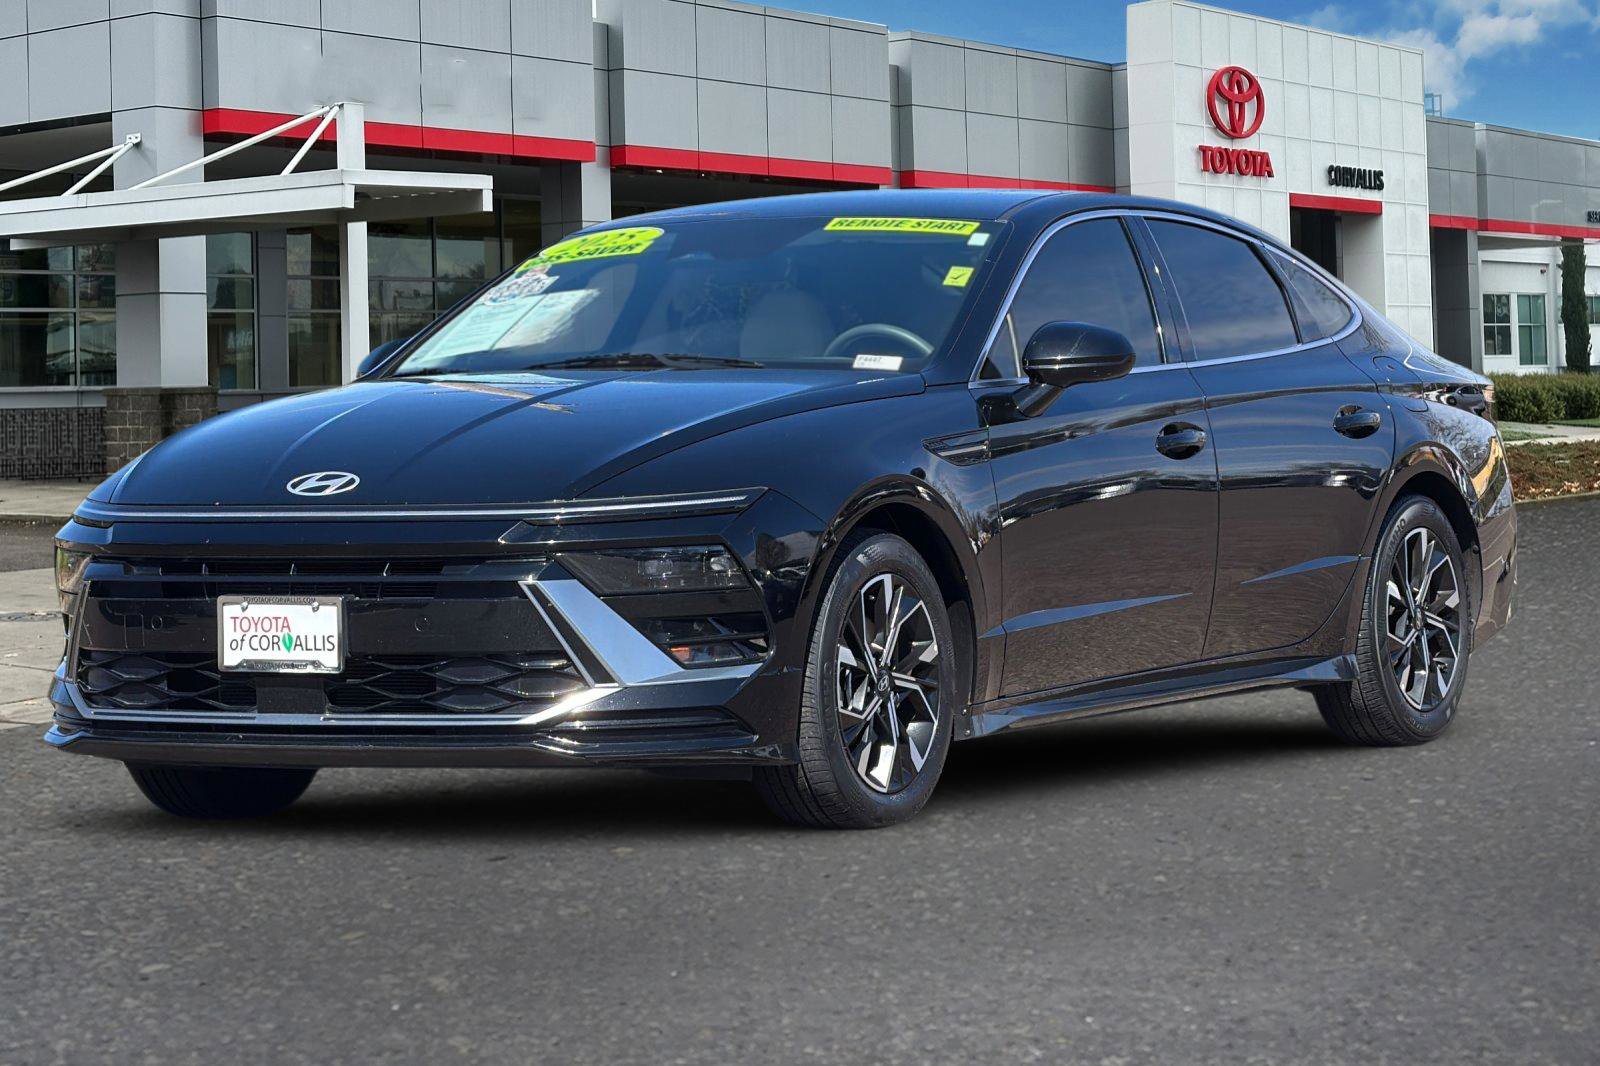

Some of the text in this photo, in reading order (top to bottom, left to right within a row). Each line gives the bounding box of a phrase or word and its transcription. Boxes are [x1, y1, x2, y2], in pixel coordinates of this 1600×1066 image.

[1199, 145, 1274, 177] TOYOTA
[1328, 165, 1384, 190] CORVALLIS
[832, 219, 971, 231] REMOTE START
[230, 616, 291, 632] TOYOTA
[229, 633, 335, 652] of CORVALLIS
